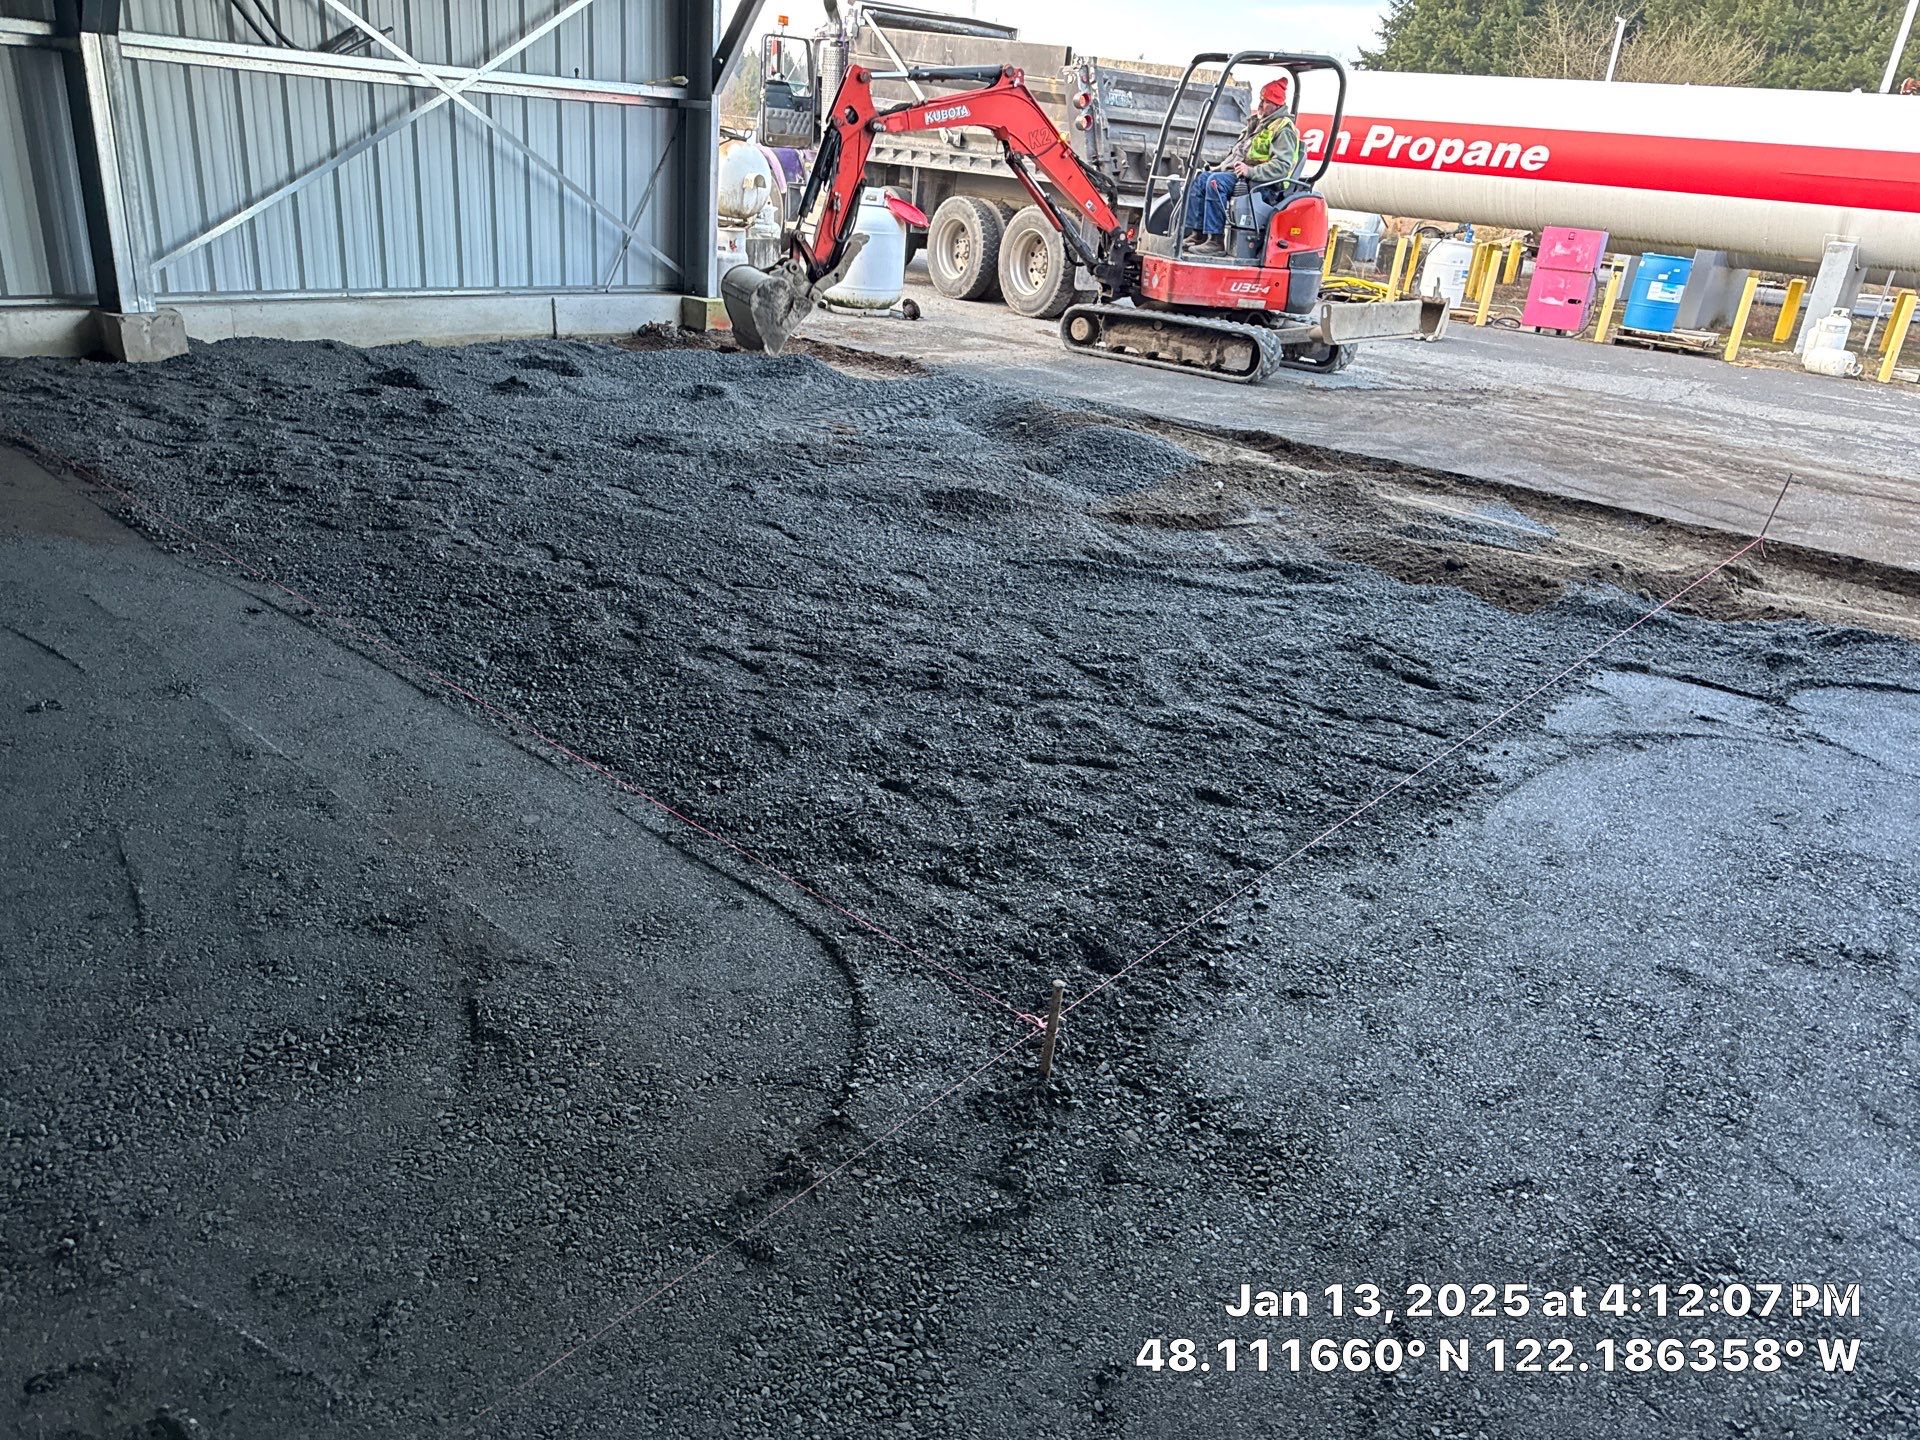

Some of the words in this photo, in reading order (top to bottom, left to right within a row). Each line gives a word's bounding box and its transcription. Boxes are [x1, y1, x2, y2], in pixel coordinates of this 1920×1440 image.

[924, 105, 970, 124] KUBOTA
[1028, 127, 1051, 149] K2
[1302, 128, 1352, 155] an
[1360, 124, 1550, 171] Propane
[1230, 281, 1271, 294] U35-4
